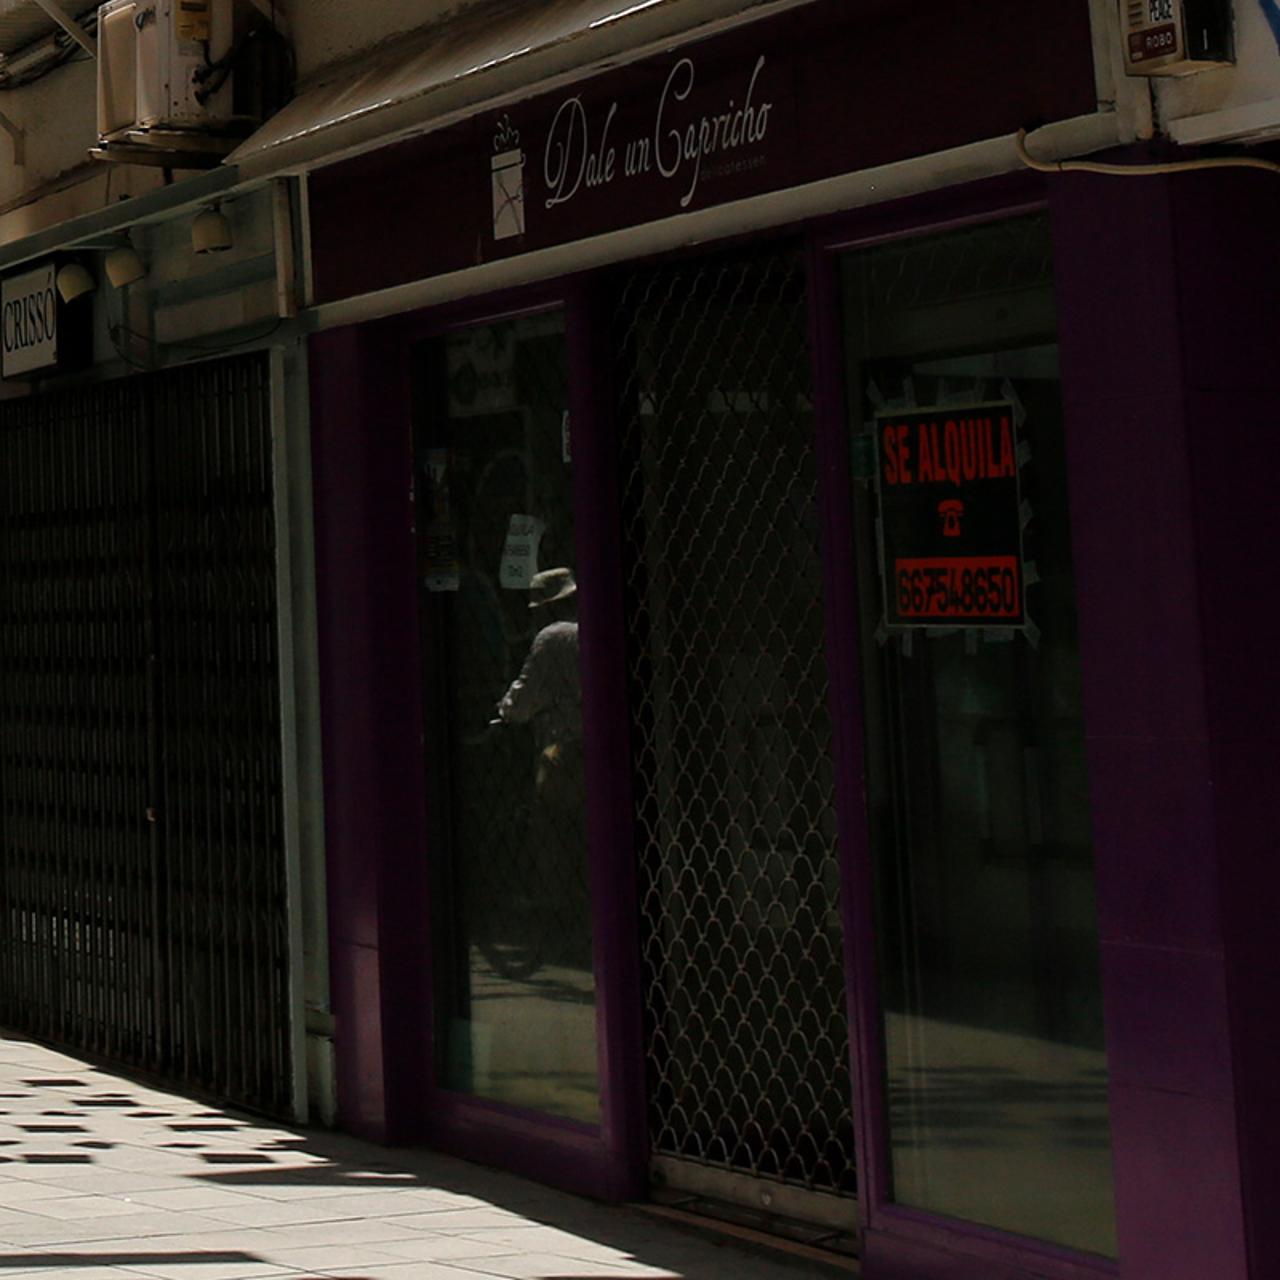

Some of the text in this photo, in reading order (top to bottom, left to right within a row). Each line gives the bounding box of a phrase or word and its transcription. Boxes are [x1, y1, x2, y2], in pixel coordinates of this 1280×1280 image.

[1145, 31, 1174, 49] ROBO
[542, 54, 774, 210] Dale un Capricho
[3, 271, 56, 352] CRISSÓ
[881, 416, 1017, 487] SE ALQUILA
